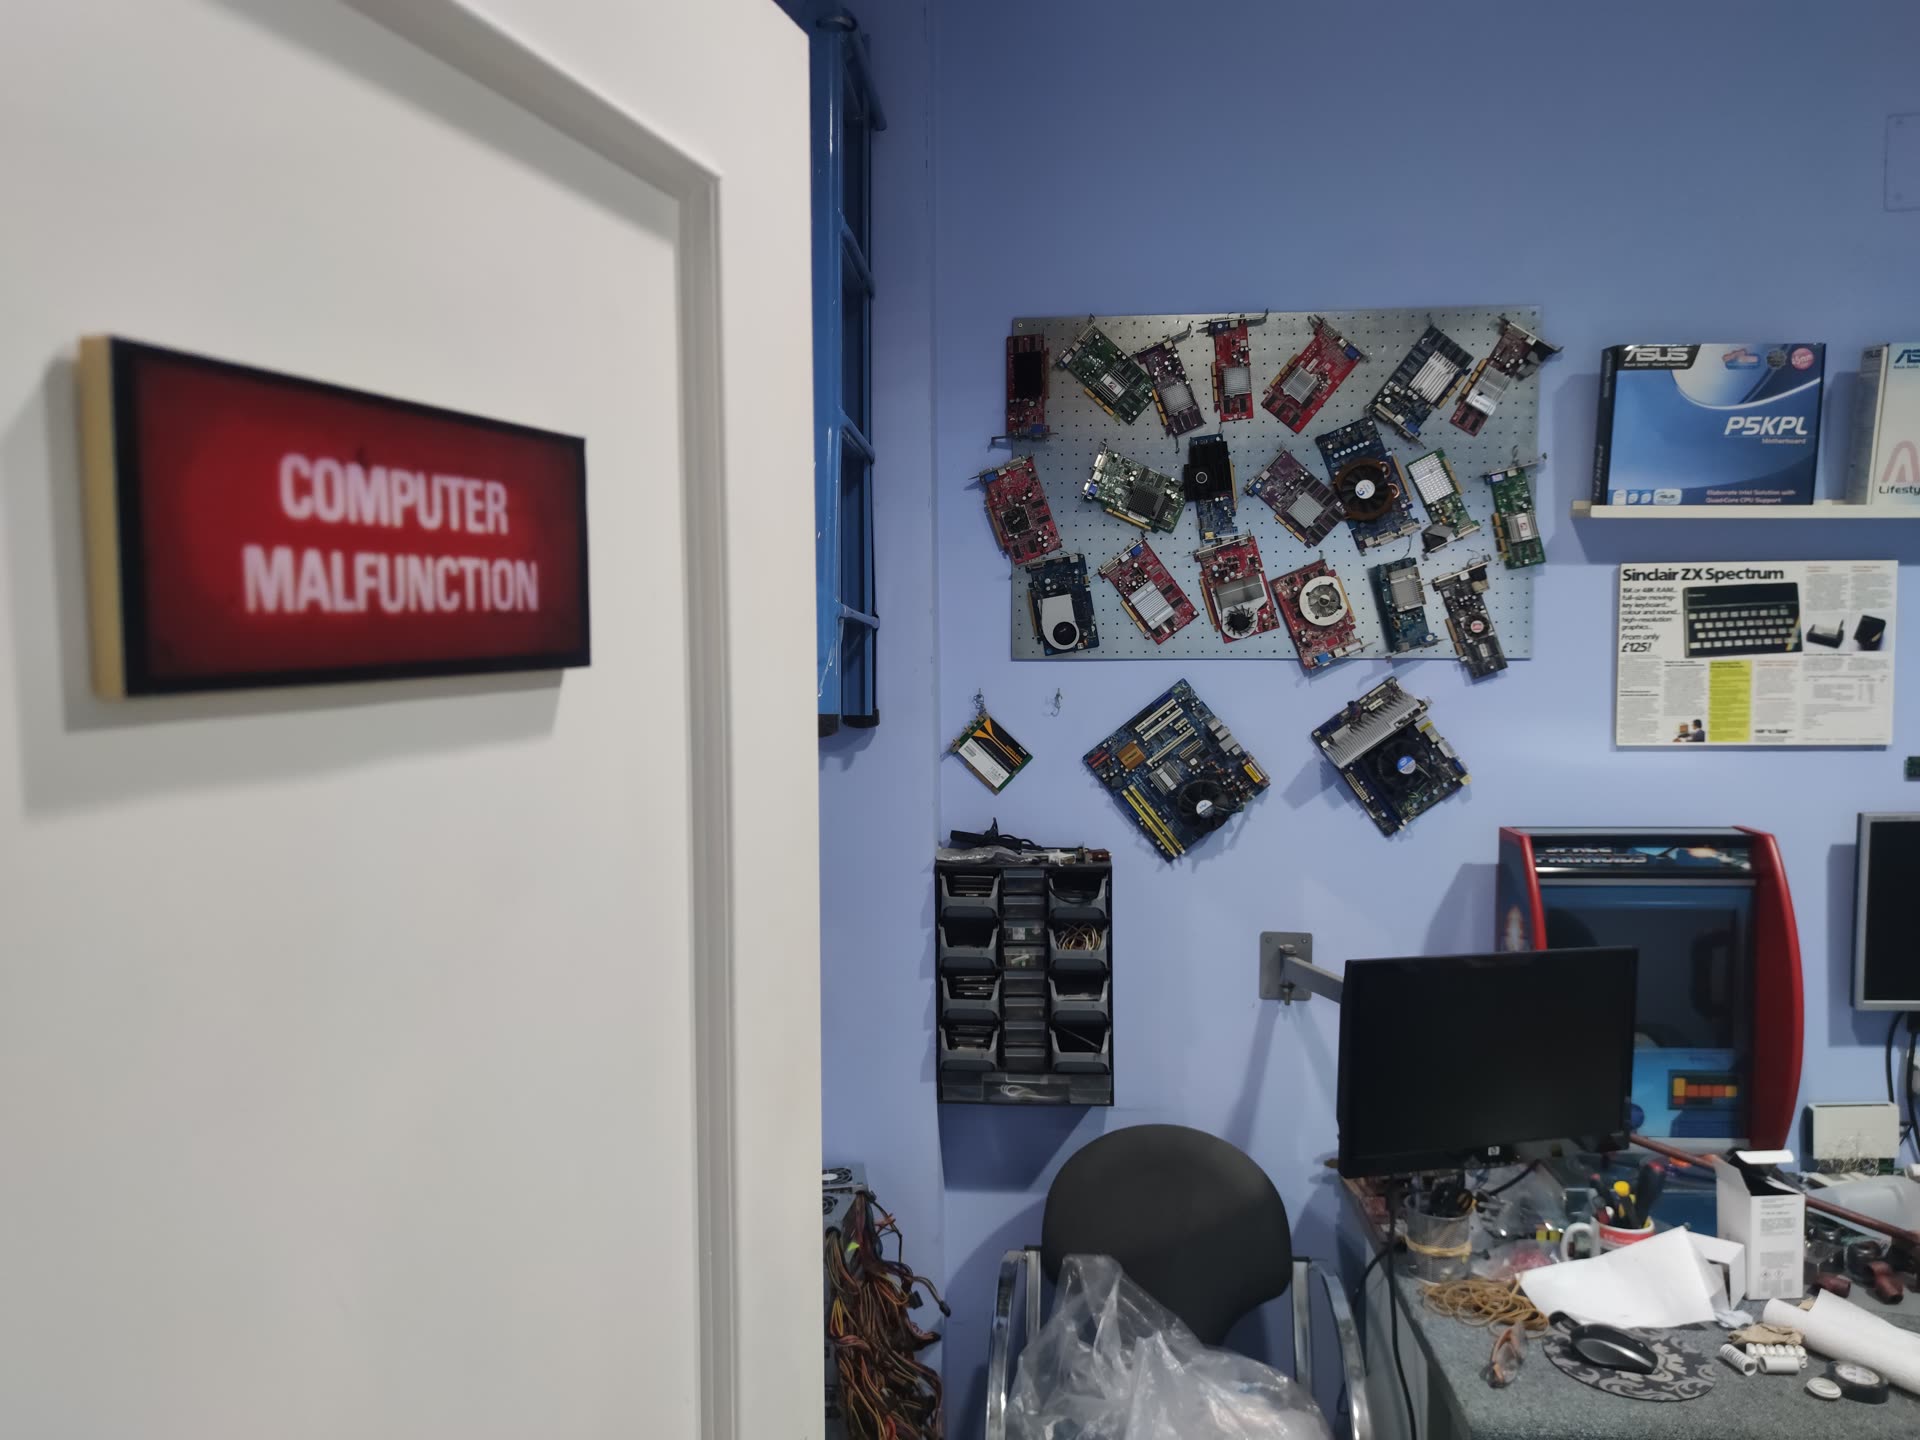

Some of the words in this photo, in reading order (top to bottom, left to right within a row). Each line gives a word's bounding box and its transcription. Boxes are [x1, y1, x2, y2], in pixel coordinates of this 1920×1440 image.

[1624, 347, 1689, 361] ASUS
[1724, 416, 1808, 435] P5KPL
[279, 452, 509, 535] COMPUTER
[242, 544, 540, 614] MALFUNCTION
[1622, 568, 1679, 581] Sinclair
[1681, 568, 1703, 580] ZX
[1705, 568, 1784, 583] Spectrum
[1643, 633, 1660, 642] only
[1621, 642, 1652, 652] £125!
